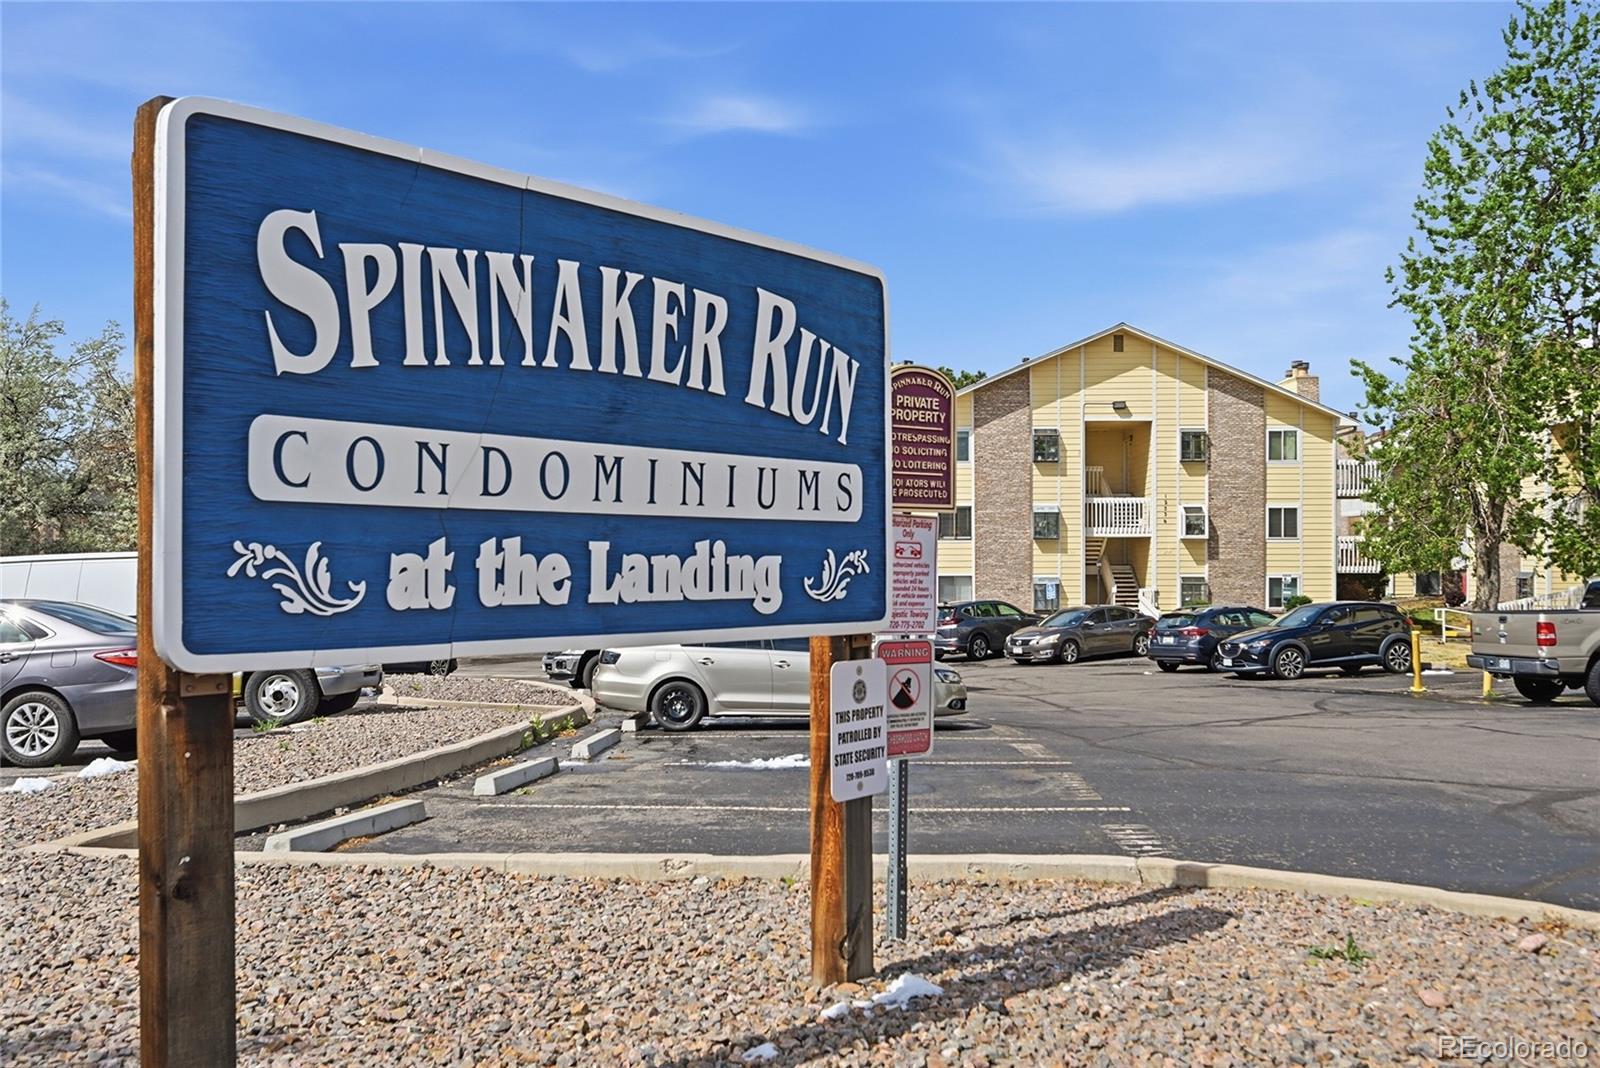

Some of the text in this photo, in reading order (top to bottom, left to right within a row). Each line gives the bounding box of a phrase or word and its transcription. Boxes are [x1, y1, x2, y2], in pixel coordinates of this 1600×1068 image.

[256, 208, 861, 446] SPINNAKER RUN
[933, 381, 951, 400] RUN
[896, 395, 940, 410] PRIVATE
[897, 432, 951, 445] TRESPASSING
[902, 446, 948, 457] SOLICITING
[272, 430, 853, 513] CONDOMINIUMS
[902, 460, 947, 471] LOITERING
[898, 488, 948, 498] PROSECUTED
[386, 536, 783, 615] at the Landing
[881, 648, 930, 658] WARNING
[835, 710, 851, 725] THIS
[852, 705, 884, 722] PROPERTY
[838, 728, 872, 745] PATROLLED
[873, 726, 882, 739] BY
[834, 746, 885, 767] STATE SECURITY
